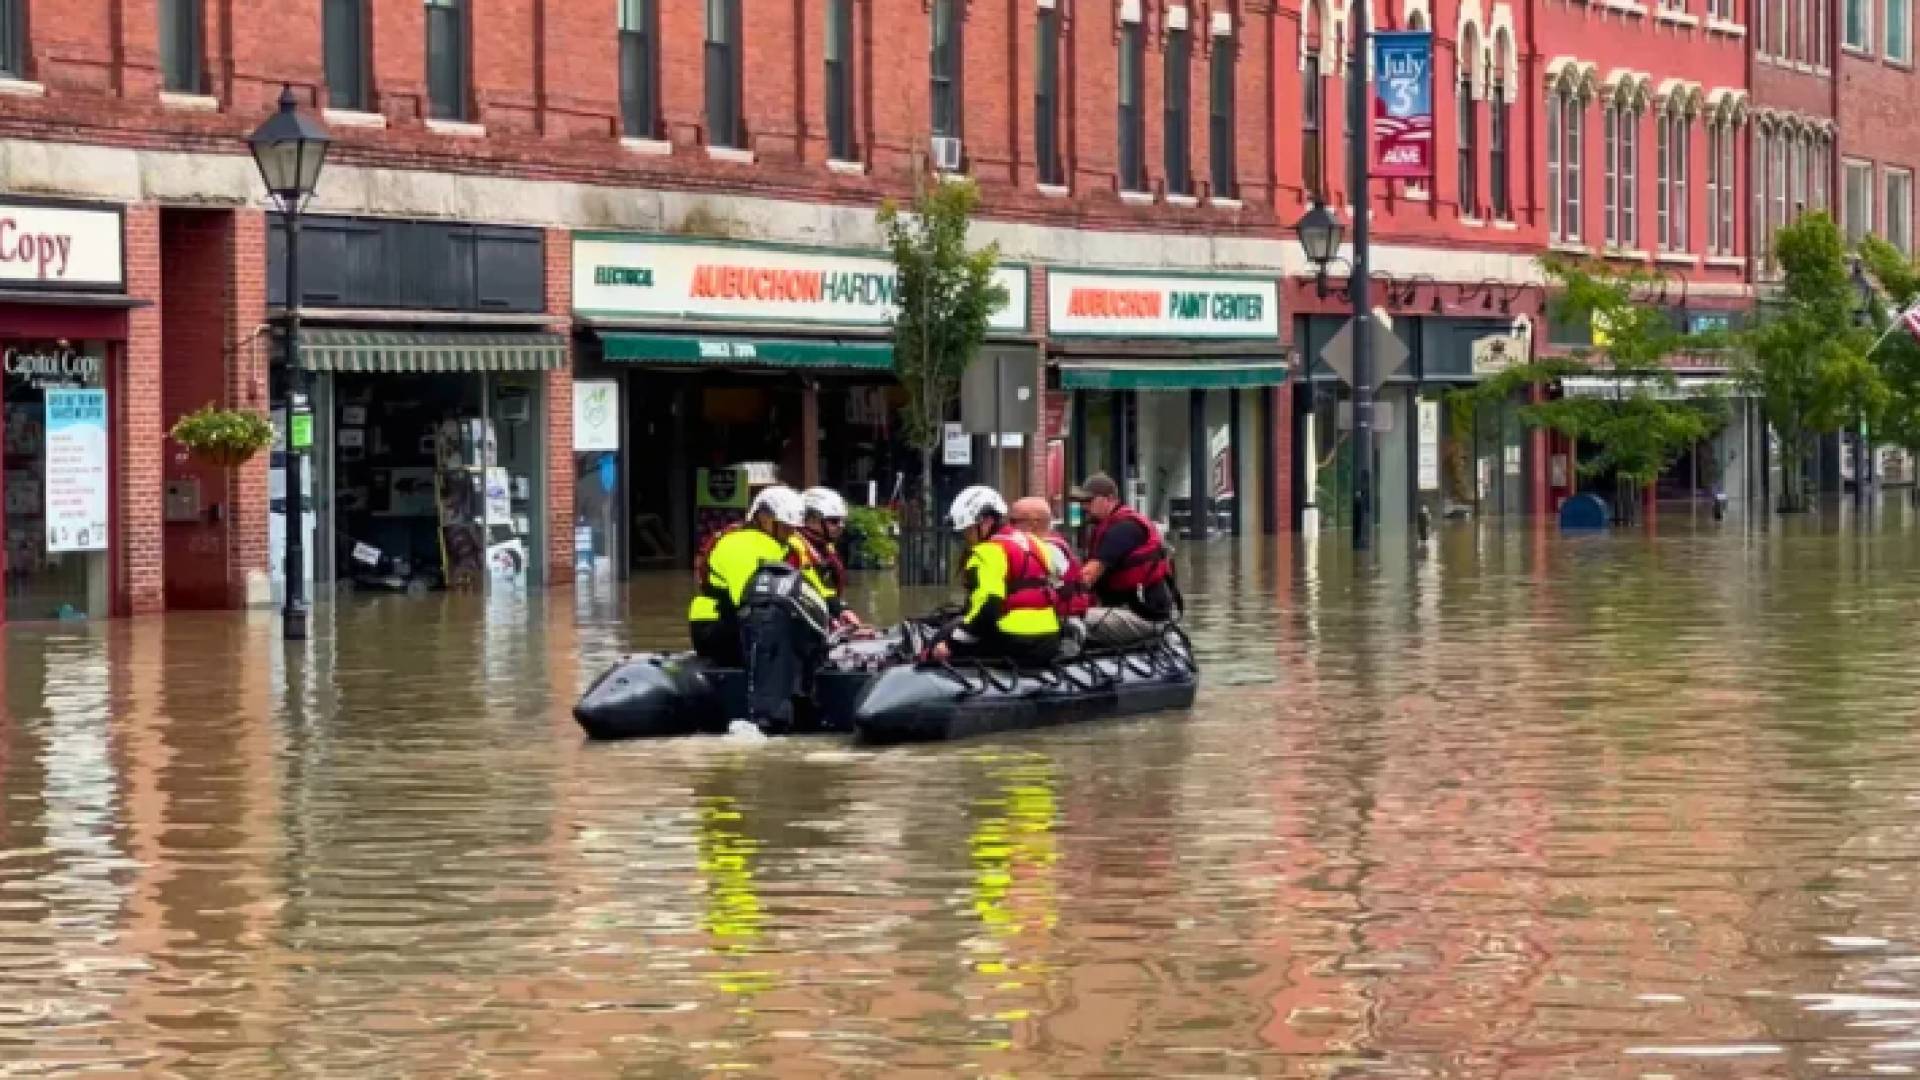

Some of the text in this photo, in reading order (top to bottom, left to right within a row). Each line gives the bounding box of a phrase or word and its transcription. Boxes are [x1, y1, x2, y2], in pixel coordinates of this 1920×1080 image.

[1379, 47, 1424, 81] July
[0, 217, 71, 279] Copy
[1169, 291, 1209, 319] PAINT
[1213, 292, 1264, 321] CENTER
